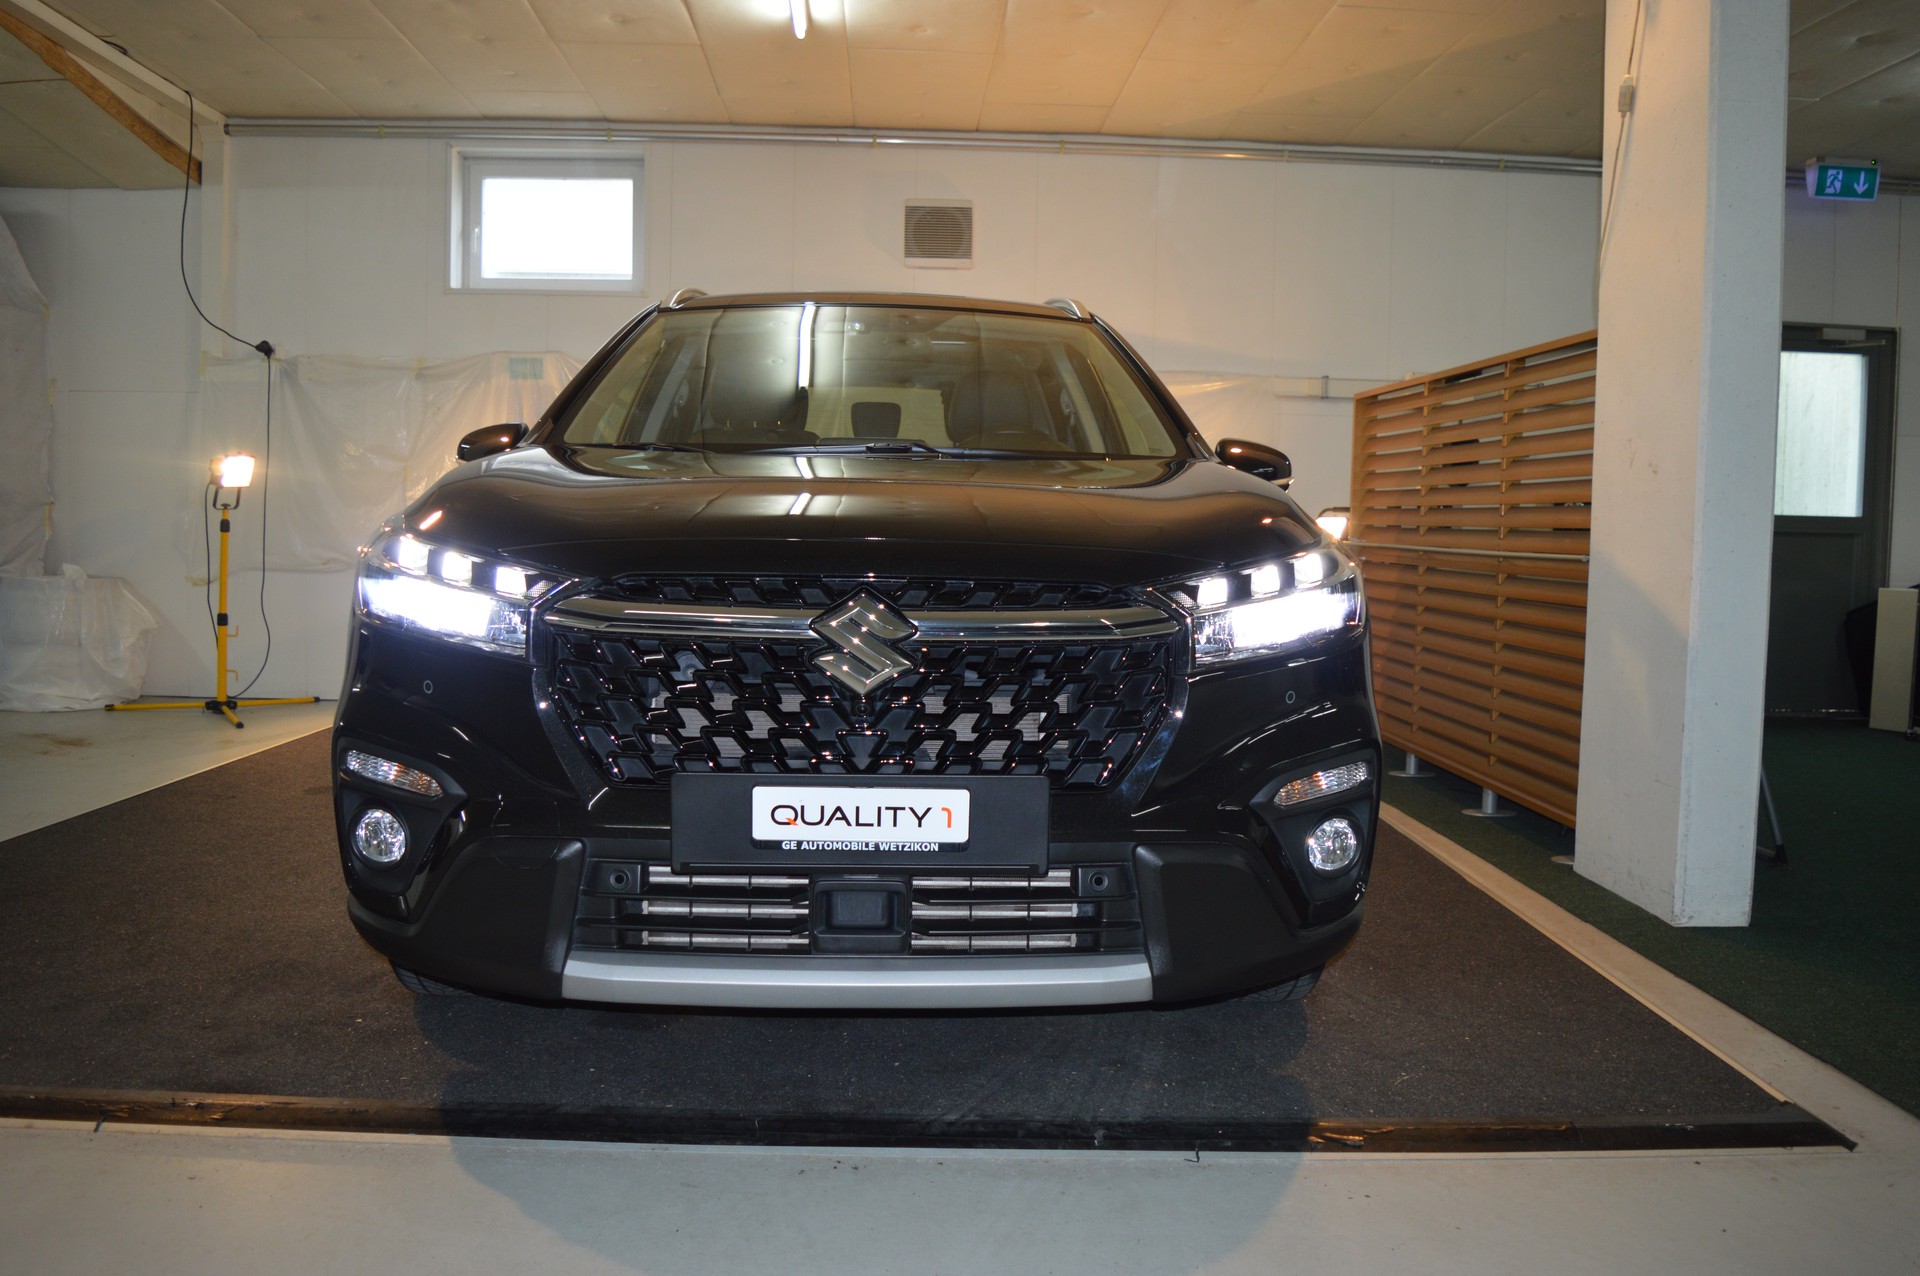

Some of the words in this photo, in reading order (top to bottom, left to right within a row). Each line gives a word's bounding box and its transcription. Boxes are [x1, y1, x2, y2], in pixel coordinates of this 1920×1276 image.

[770, 804, 933, 828] QUALITY
[941, 807, 952, 828] 1
[781, 841, 797, 850] GE
[800, 841, 875, 851] AUTOMOBILE
[878, 842, 939, 852] WETZIKON
